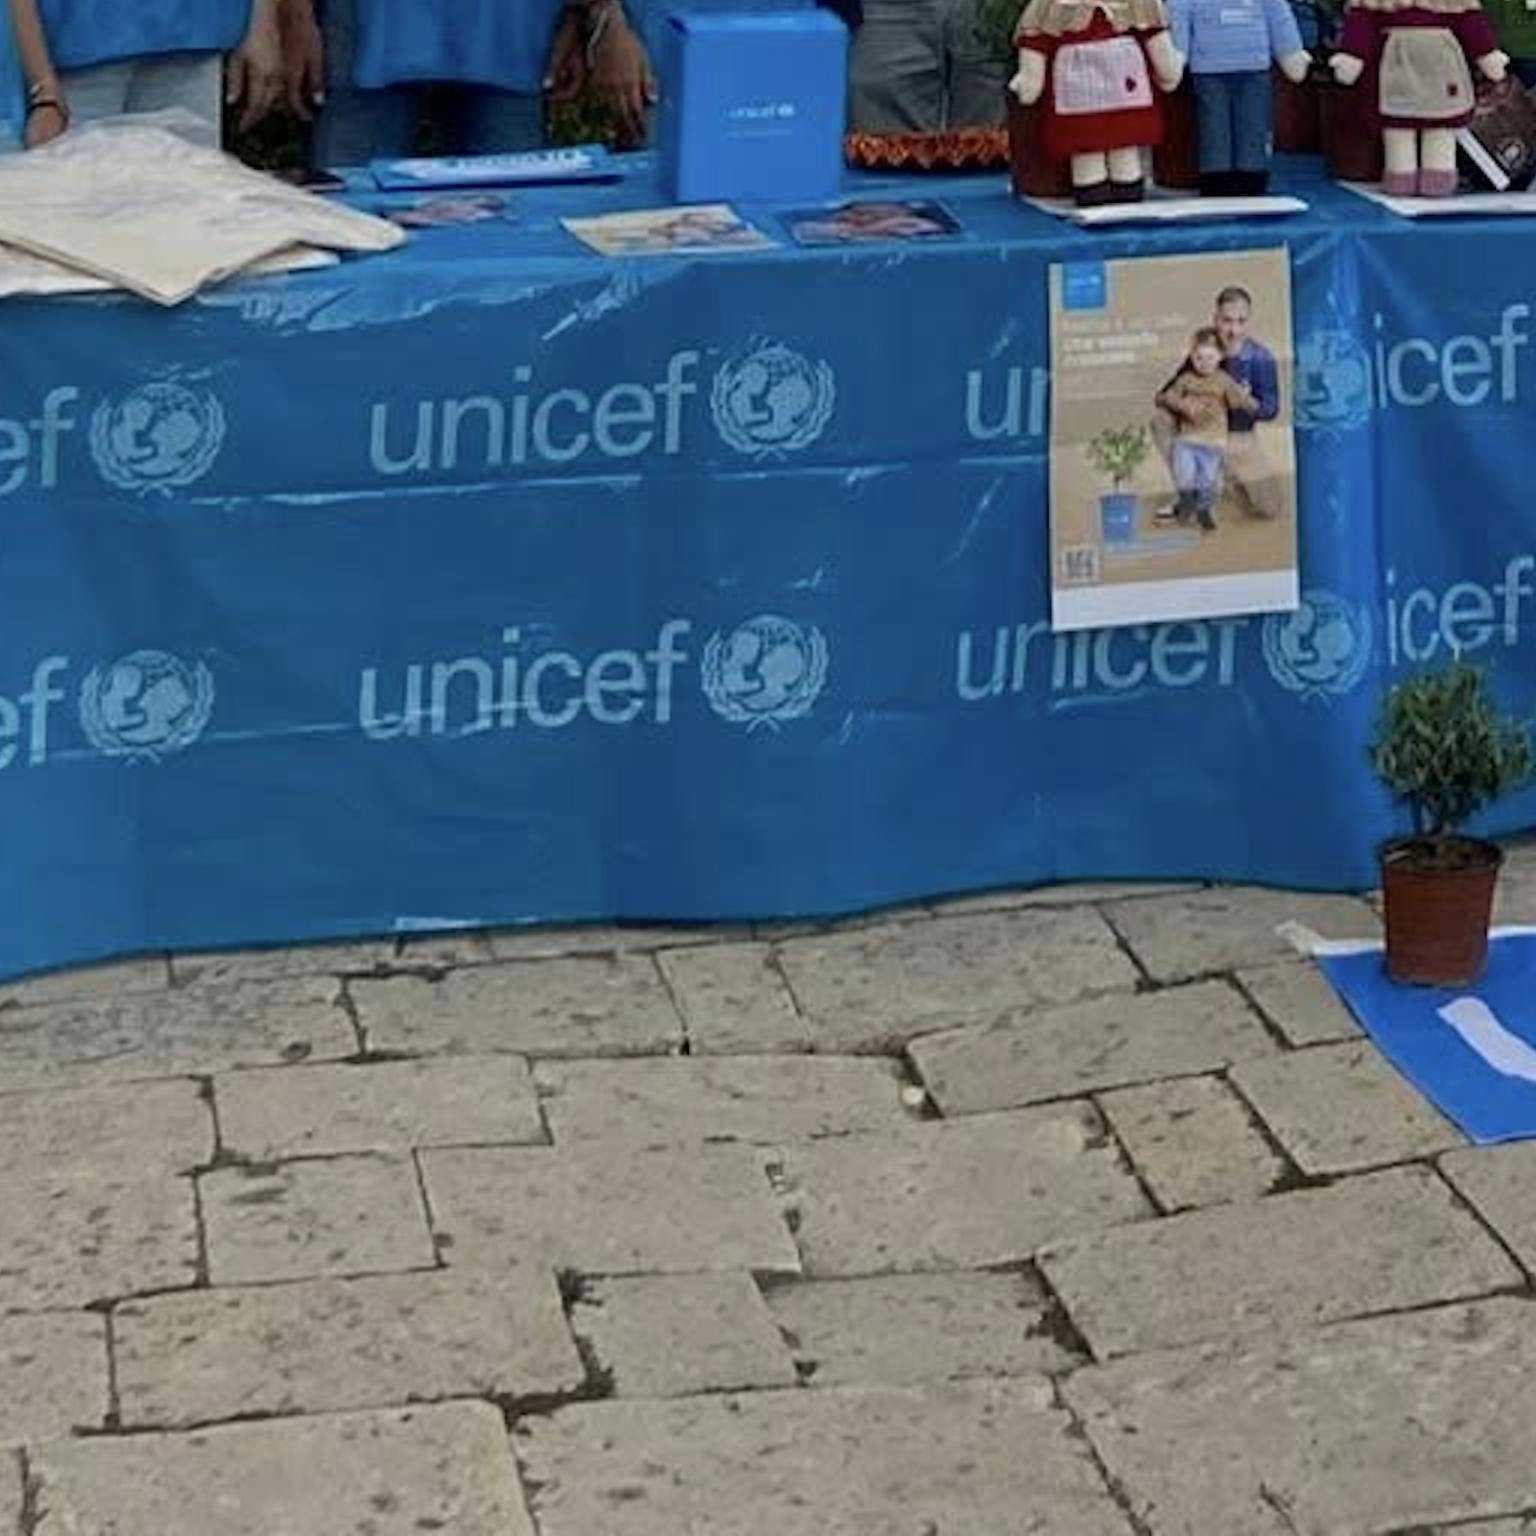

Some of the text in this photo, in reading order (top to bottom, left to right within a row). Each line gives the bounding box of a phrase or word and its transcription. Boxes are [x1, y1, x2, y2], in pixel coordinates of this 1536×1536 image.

[369, 350, 696, 474] unicef
[1374, 304, 1530, 409] icef
[1385, 556, 1534, 666] icef
[358, 619, 691, 740] unicef
